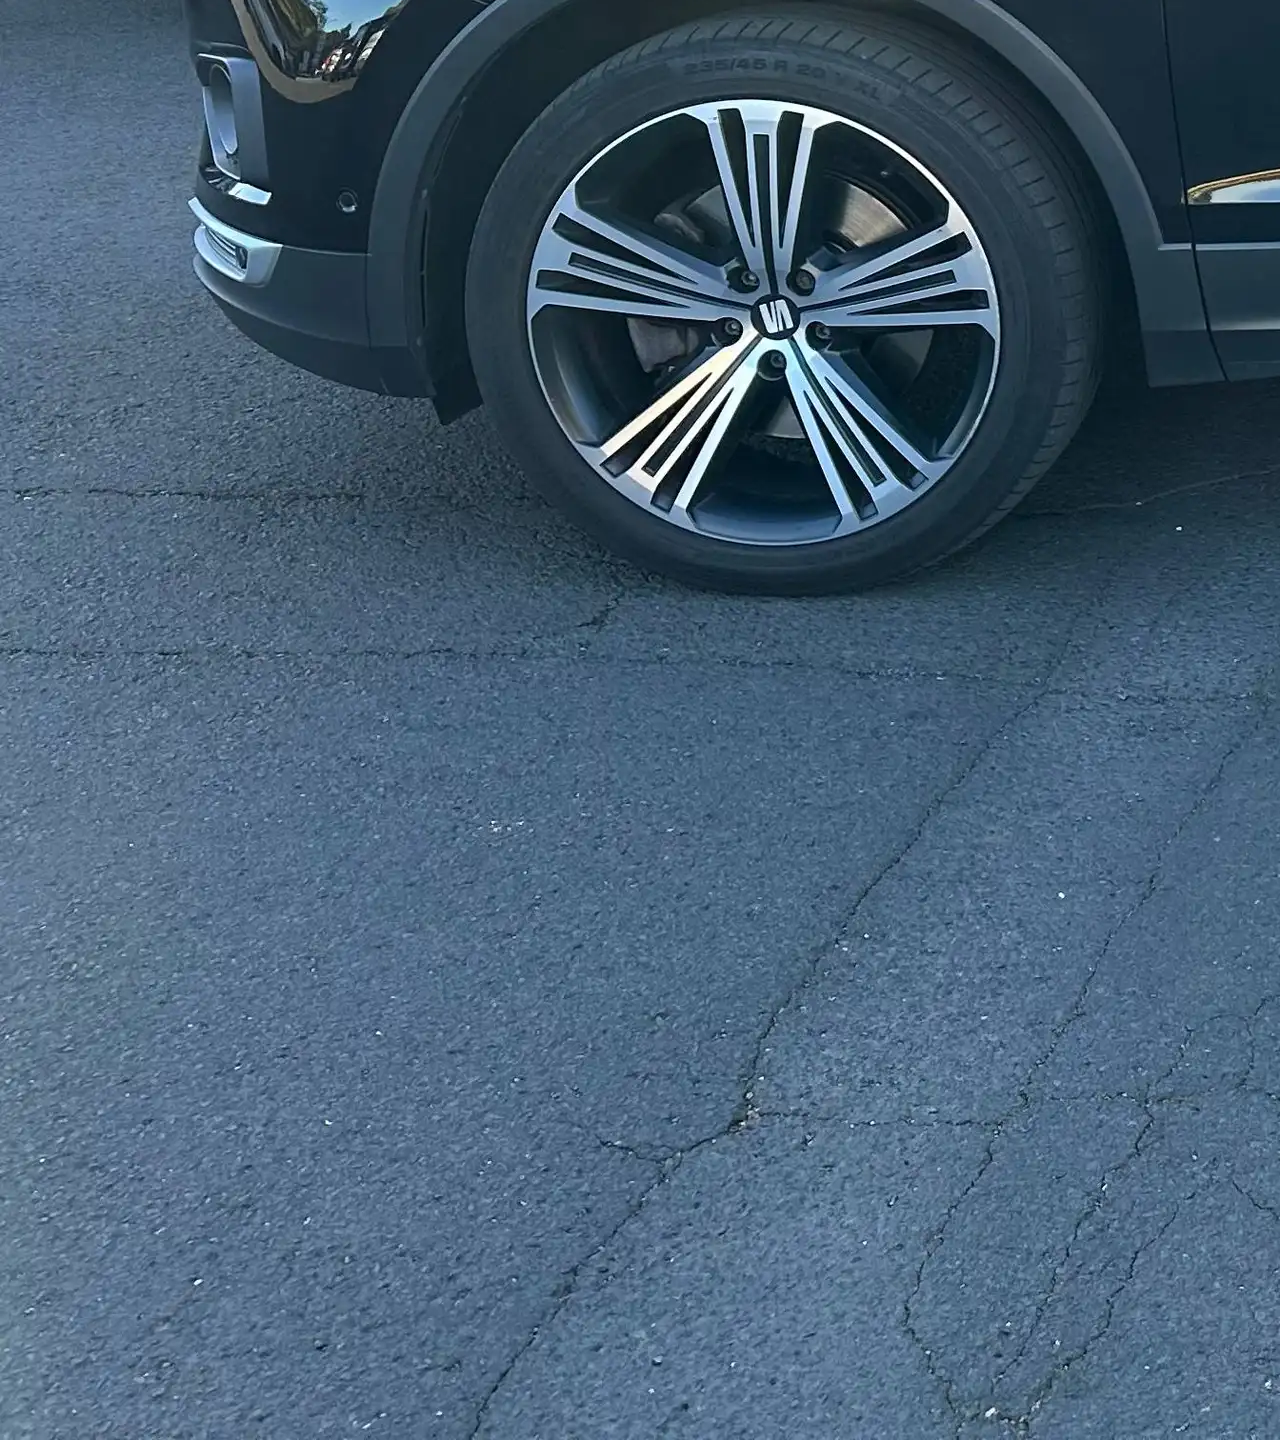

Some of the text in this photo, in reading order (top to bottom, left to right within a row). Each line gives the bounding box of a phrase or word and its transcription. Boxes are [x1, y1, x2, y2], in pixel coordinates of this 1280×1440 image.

[684, 58, 768, 76] 235/45
[774, 59, 789, 73] R
[796, 63, 826, 79] 20
